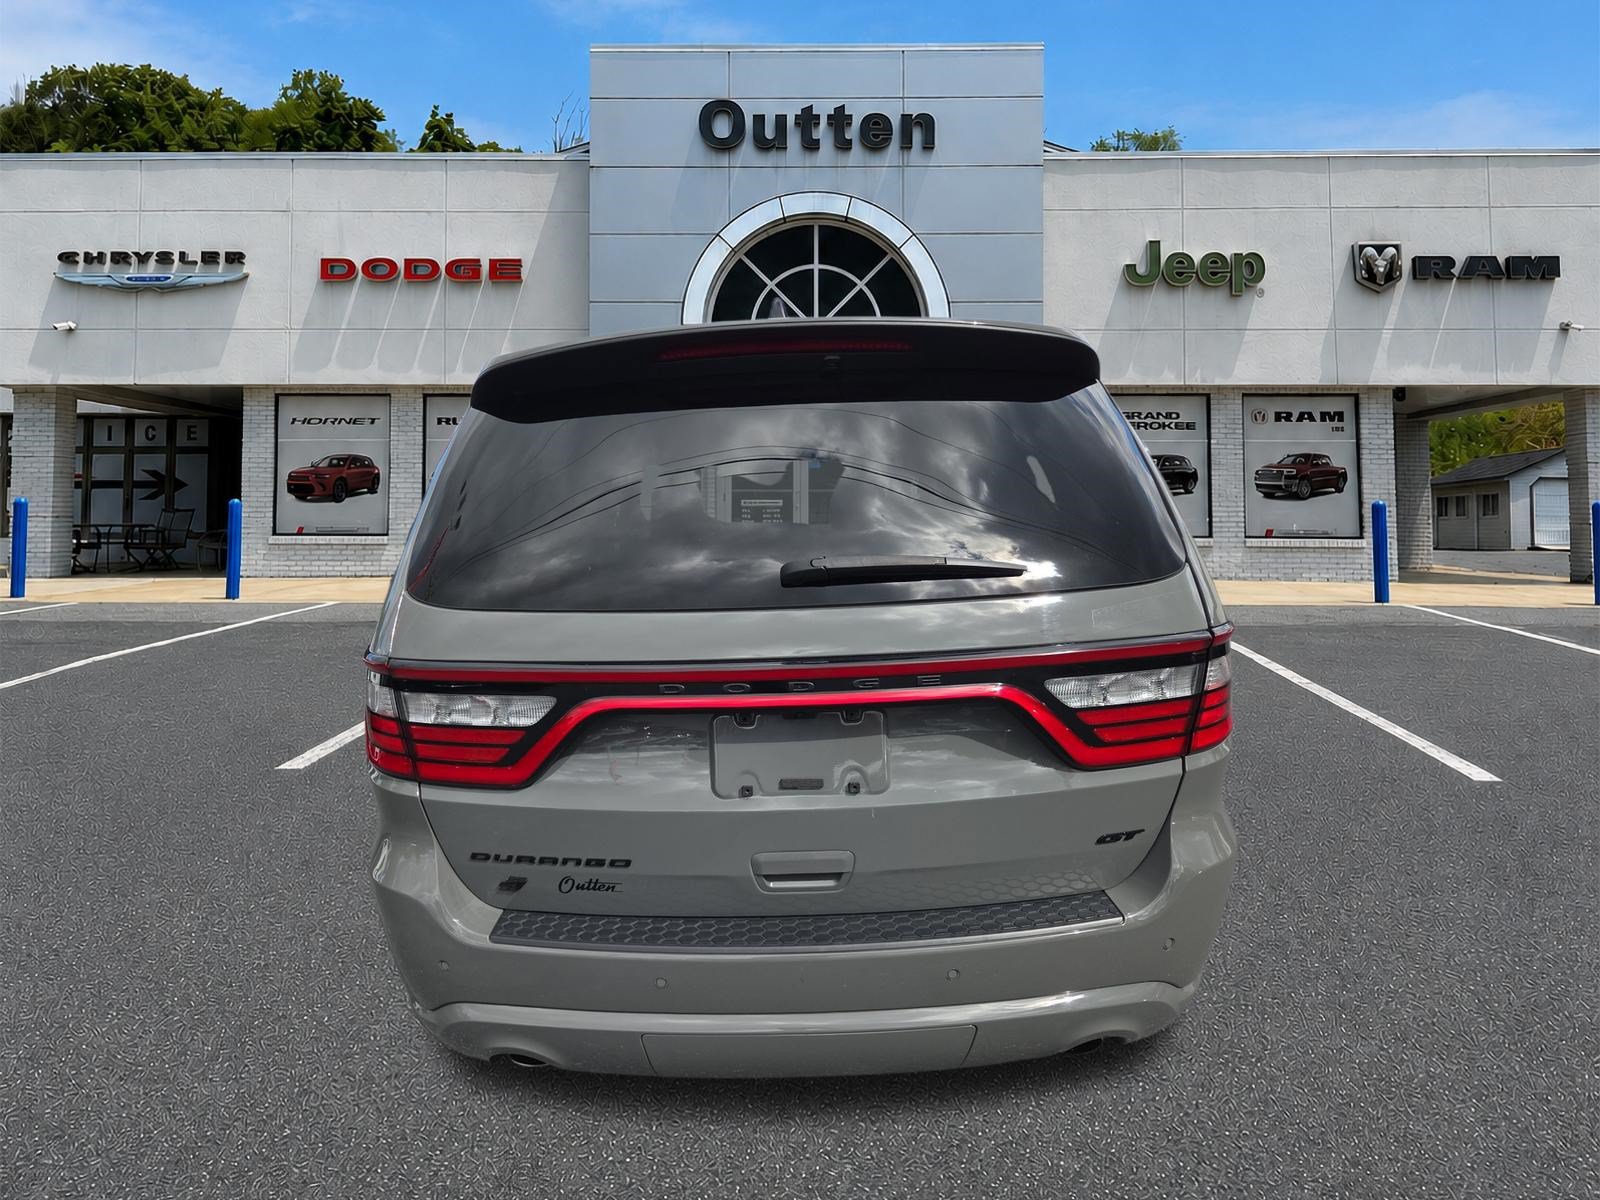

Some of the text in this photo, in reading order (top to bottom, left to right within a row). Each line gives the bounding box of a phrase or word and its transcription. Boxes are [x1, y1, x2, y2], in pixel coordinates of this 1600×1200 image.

[699, 99, 935, 151] Outten
[57, 251, 246, 265] CHRYSLER
[1411, 255, 1561, 280] RAM
[320, 258, 523, 282] DODGE
[1123, 240, 1266, 297] Jeep
[290, 417, 381, 426] HORNET
[1273, 411, 1345, 423] RAM
[658, 674, 942, 694] DODGE
[1094, 828, 1145, 846] GT
[469, 852, 633, 868] DURANGO
[558, 875, 624, 895] Outten
